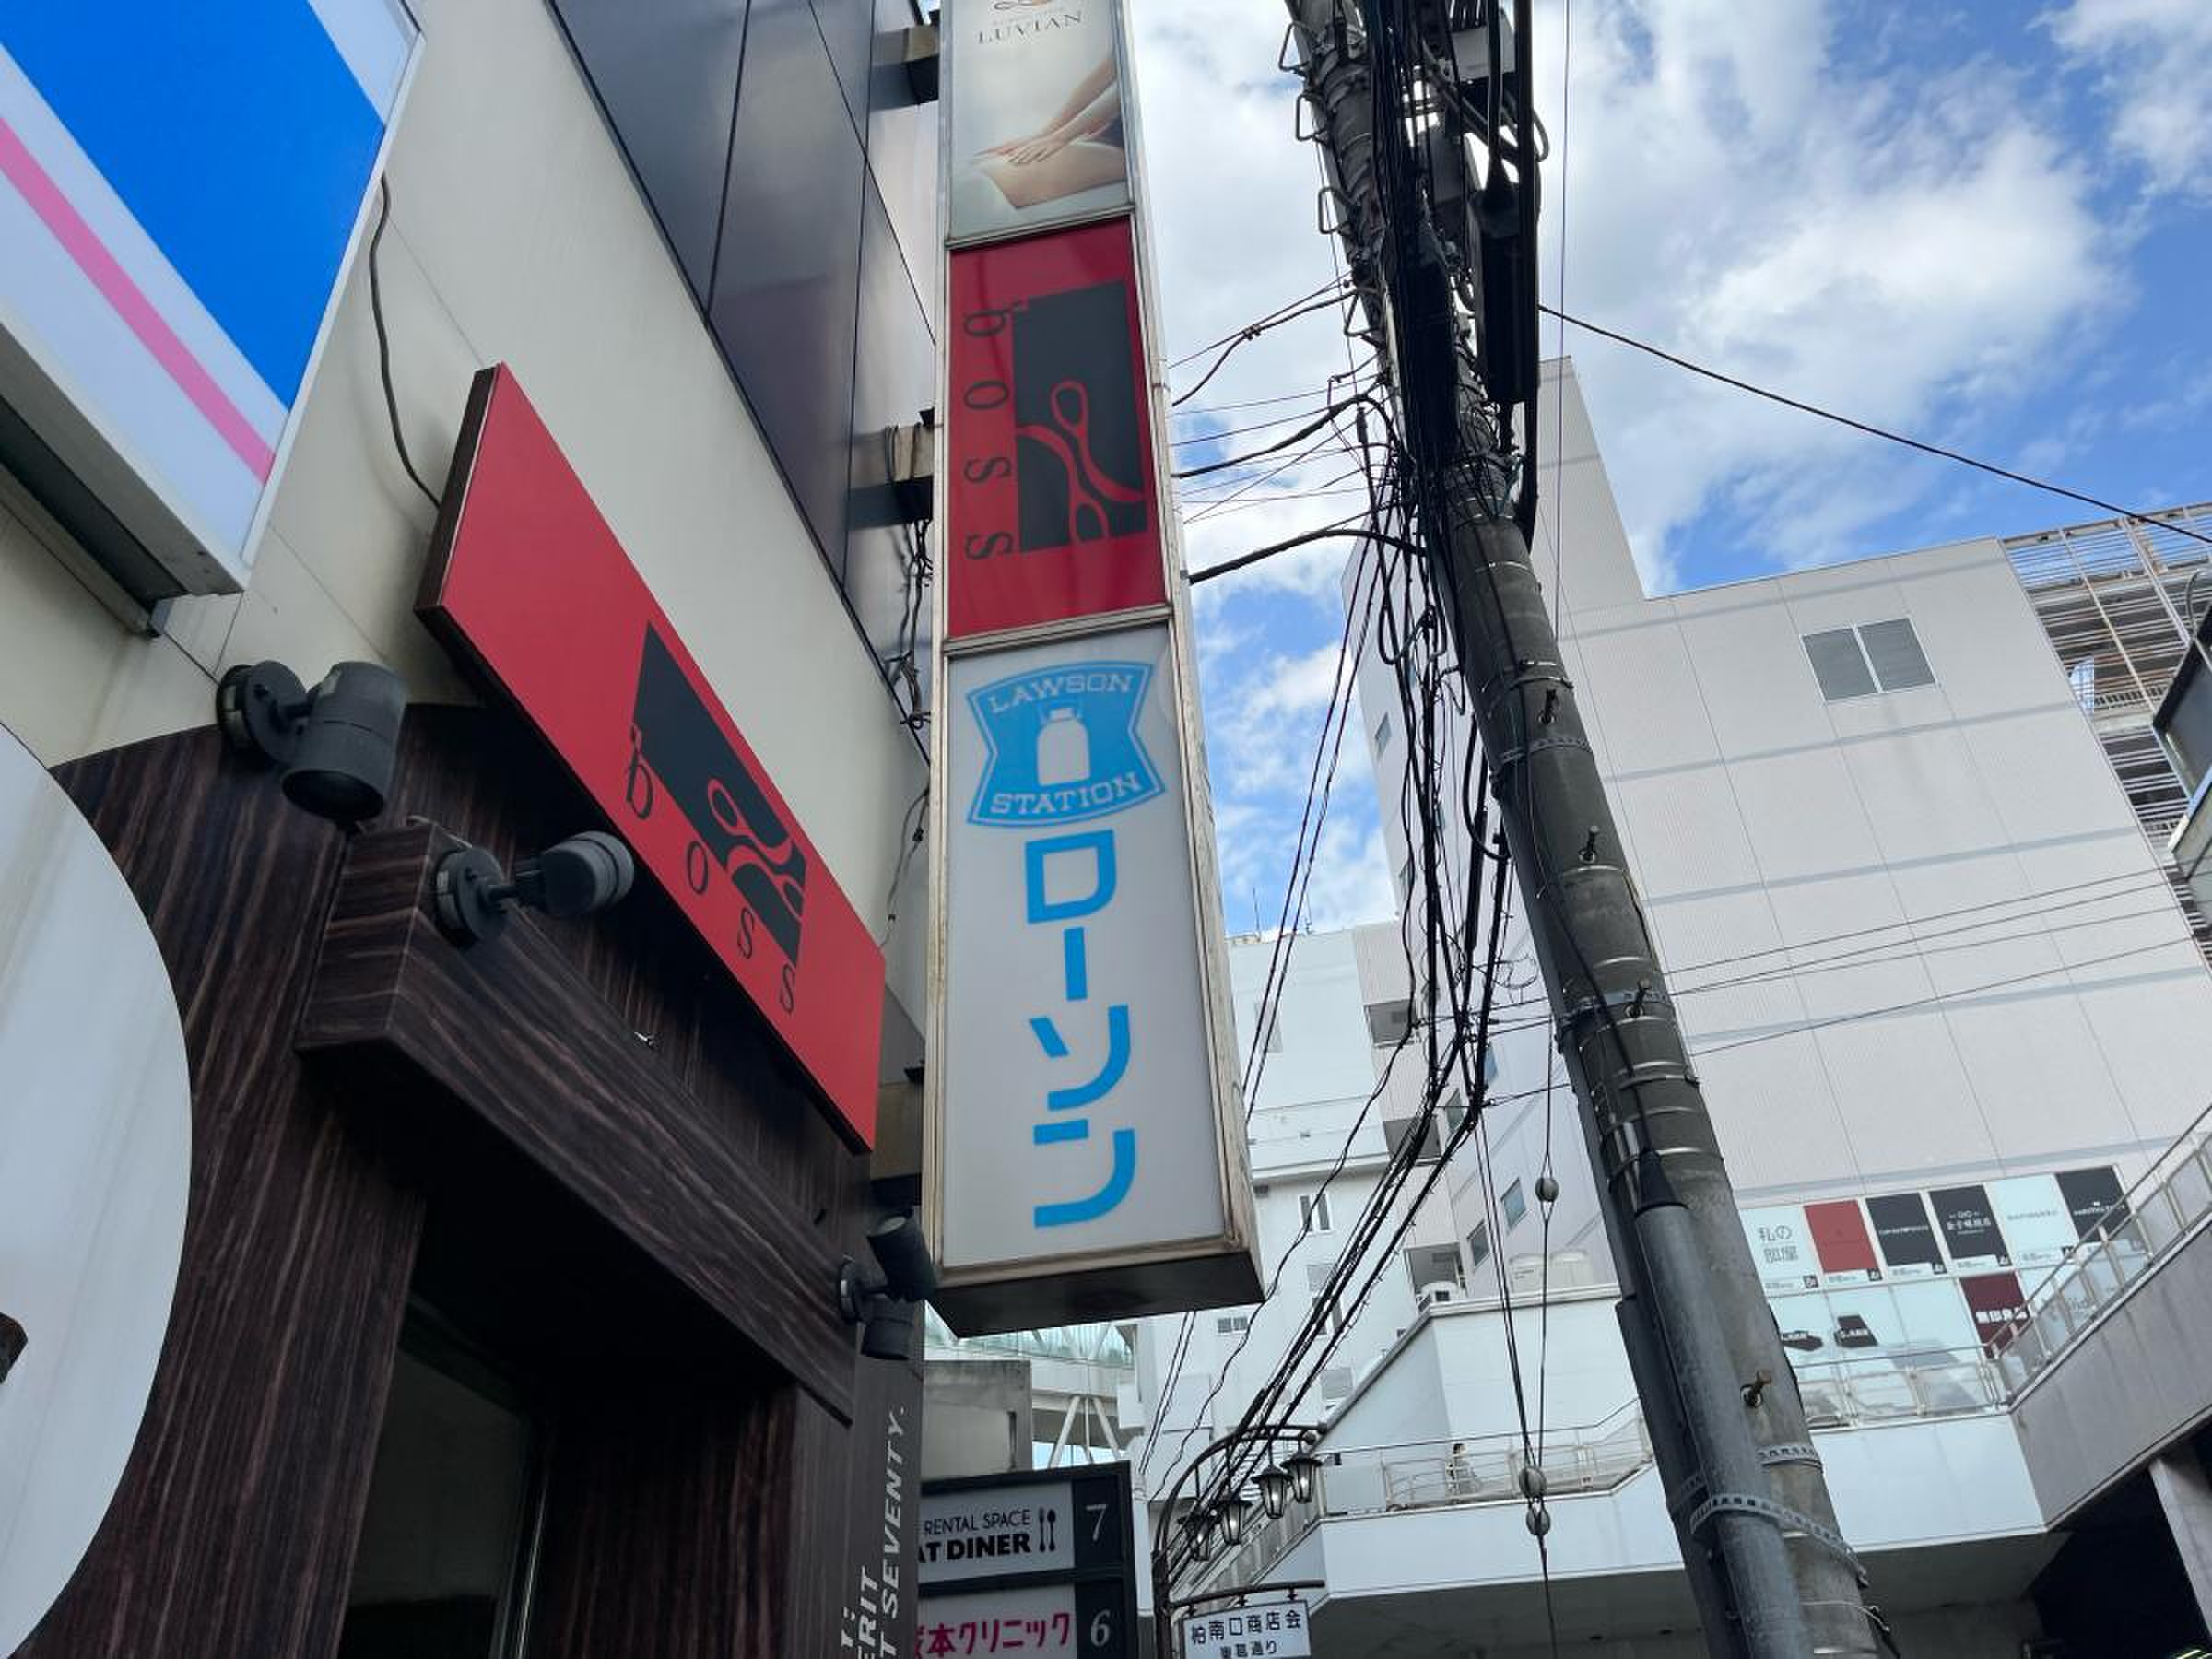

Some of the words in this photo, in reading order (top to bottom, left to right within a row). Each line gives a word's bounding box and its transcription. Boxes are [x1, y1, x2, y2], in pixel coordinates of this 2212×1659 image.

[978, 10, 1082, 44] LUVIAN
[988, 673, 1134, 714] LAWSON
[990, 771, 1143, 815] STATION
[1025, 829, 1136, 1228] ローソン
[924, 1513, 981, 1535] RENTAL
[982, 1508, 1031, 1530] SPACE
[1086, 1503, 1108, 1542] 7
[947, 1533, 1032, 1561] DINER
[1090, 1609, 1111, 1648] 6
[1192, 1609, 1301, 1645] 柏南口商店会
